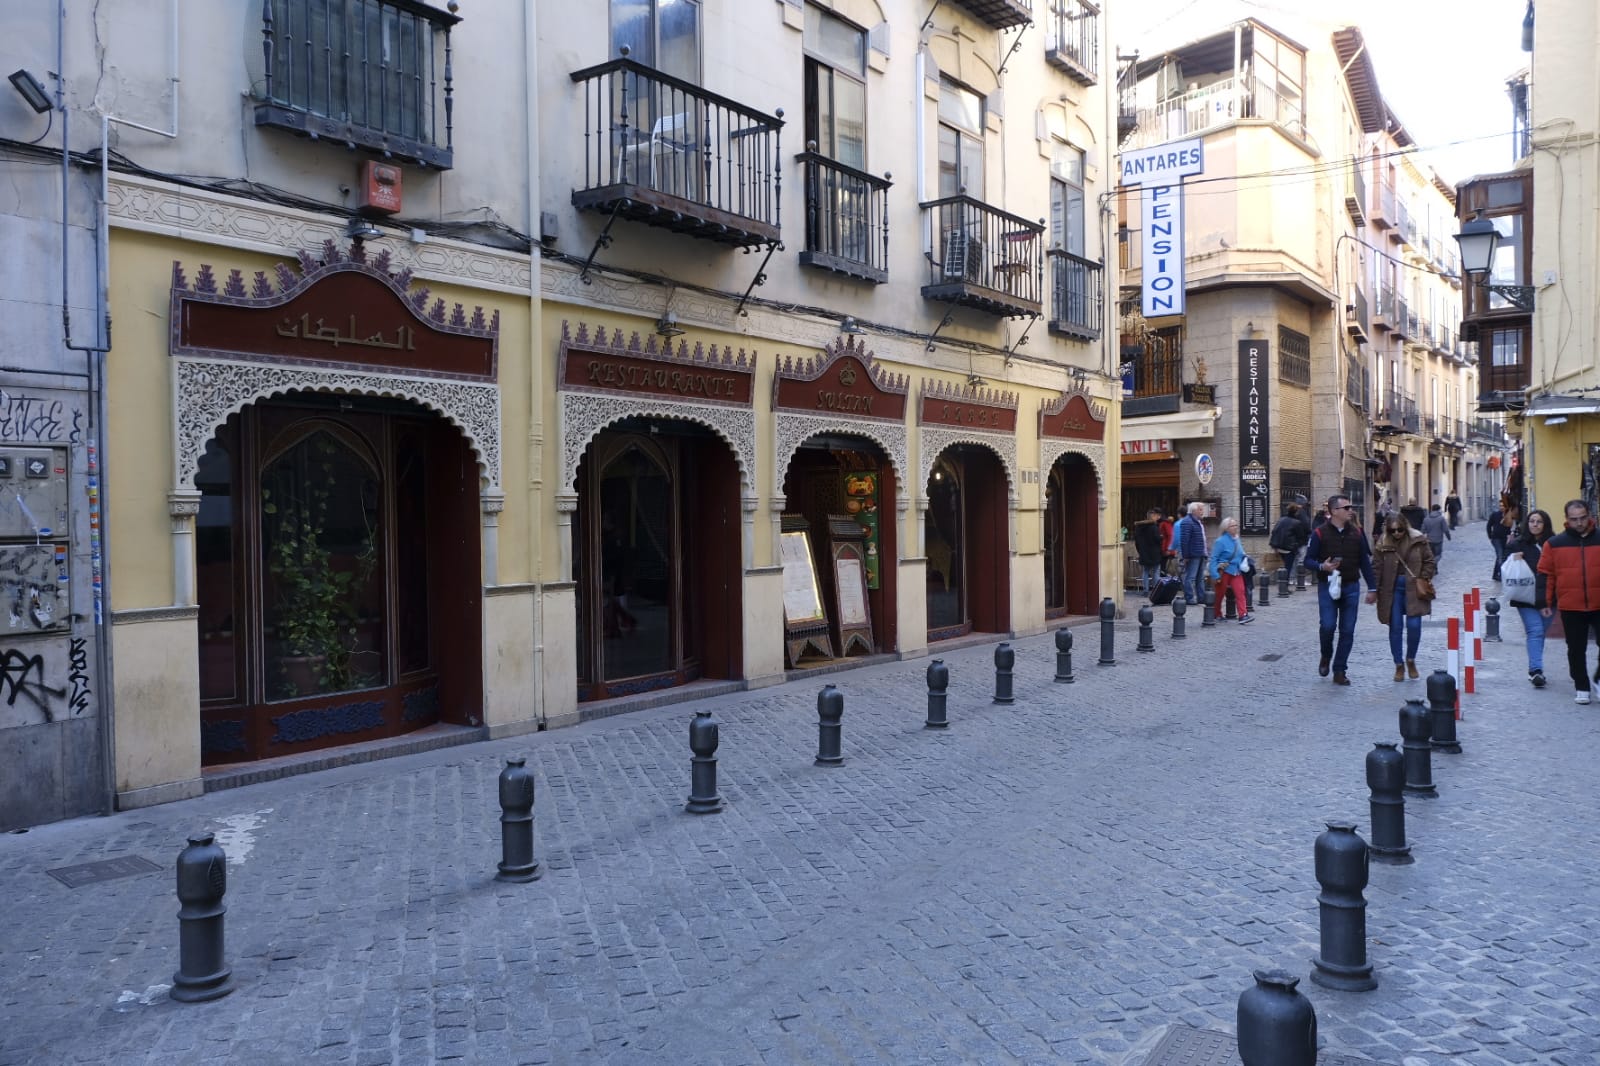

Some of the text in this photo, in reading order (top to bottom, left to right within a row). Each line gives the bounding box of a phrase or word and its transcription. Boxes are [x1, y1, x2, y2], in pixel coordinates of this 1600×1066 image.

[1124, 148, 1200, 177] ANTARES
[1151, 186, 1174, 311] PENSION
[587, 360, 736, 396] RESTAURANTE
[1249, 347, 1259, 455] RESTAURANTE
